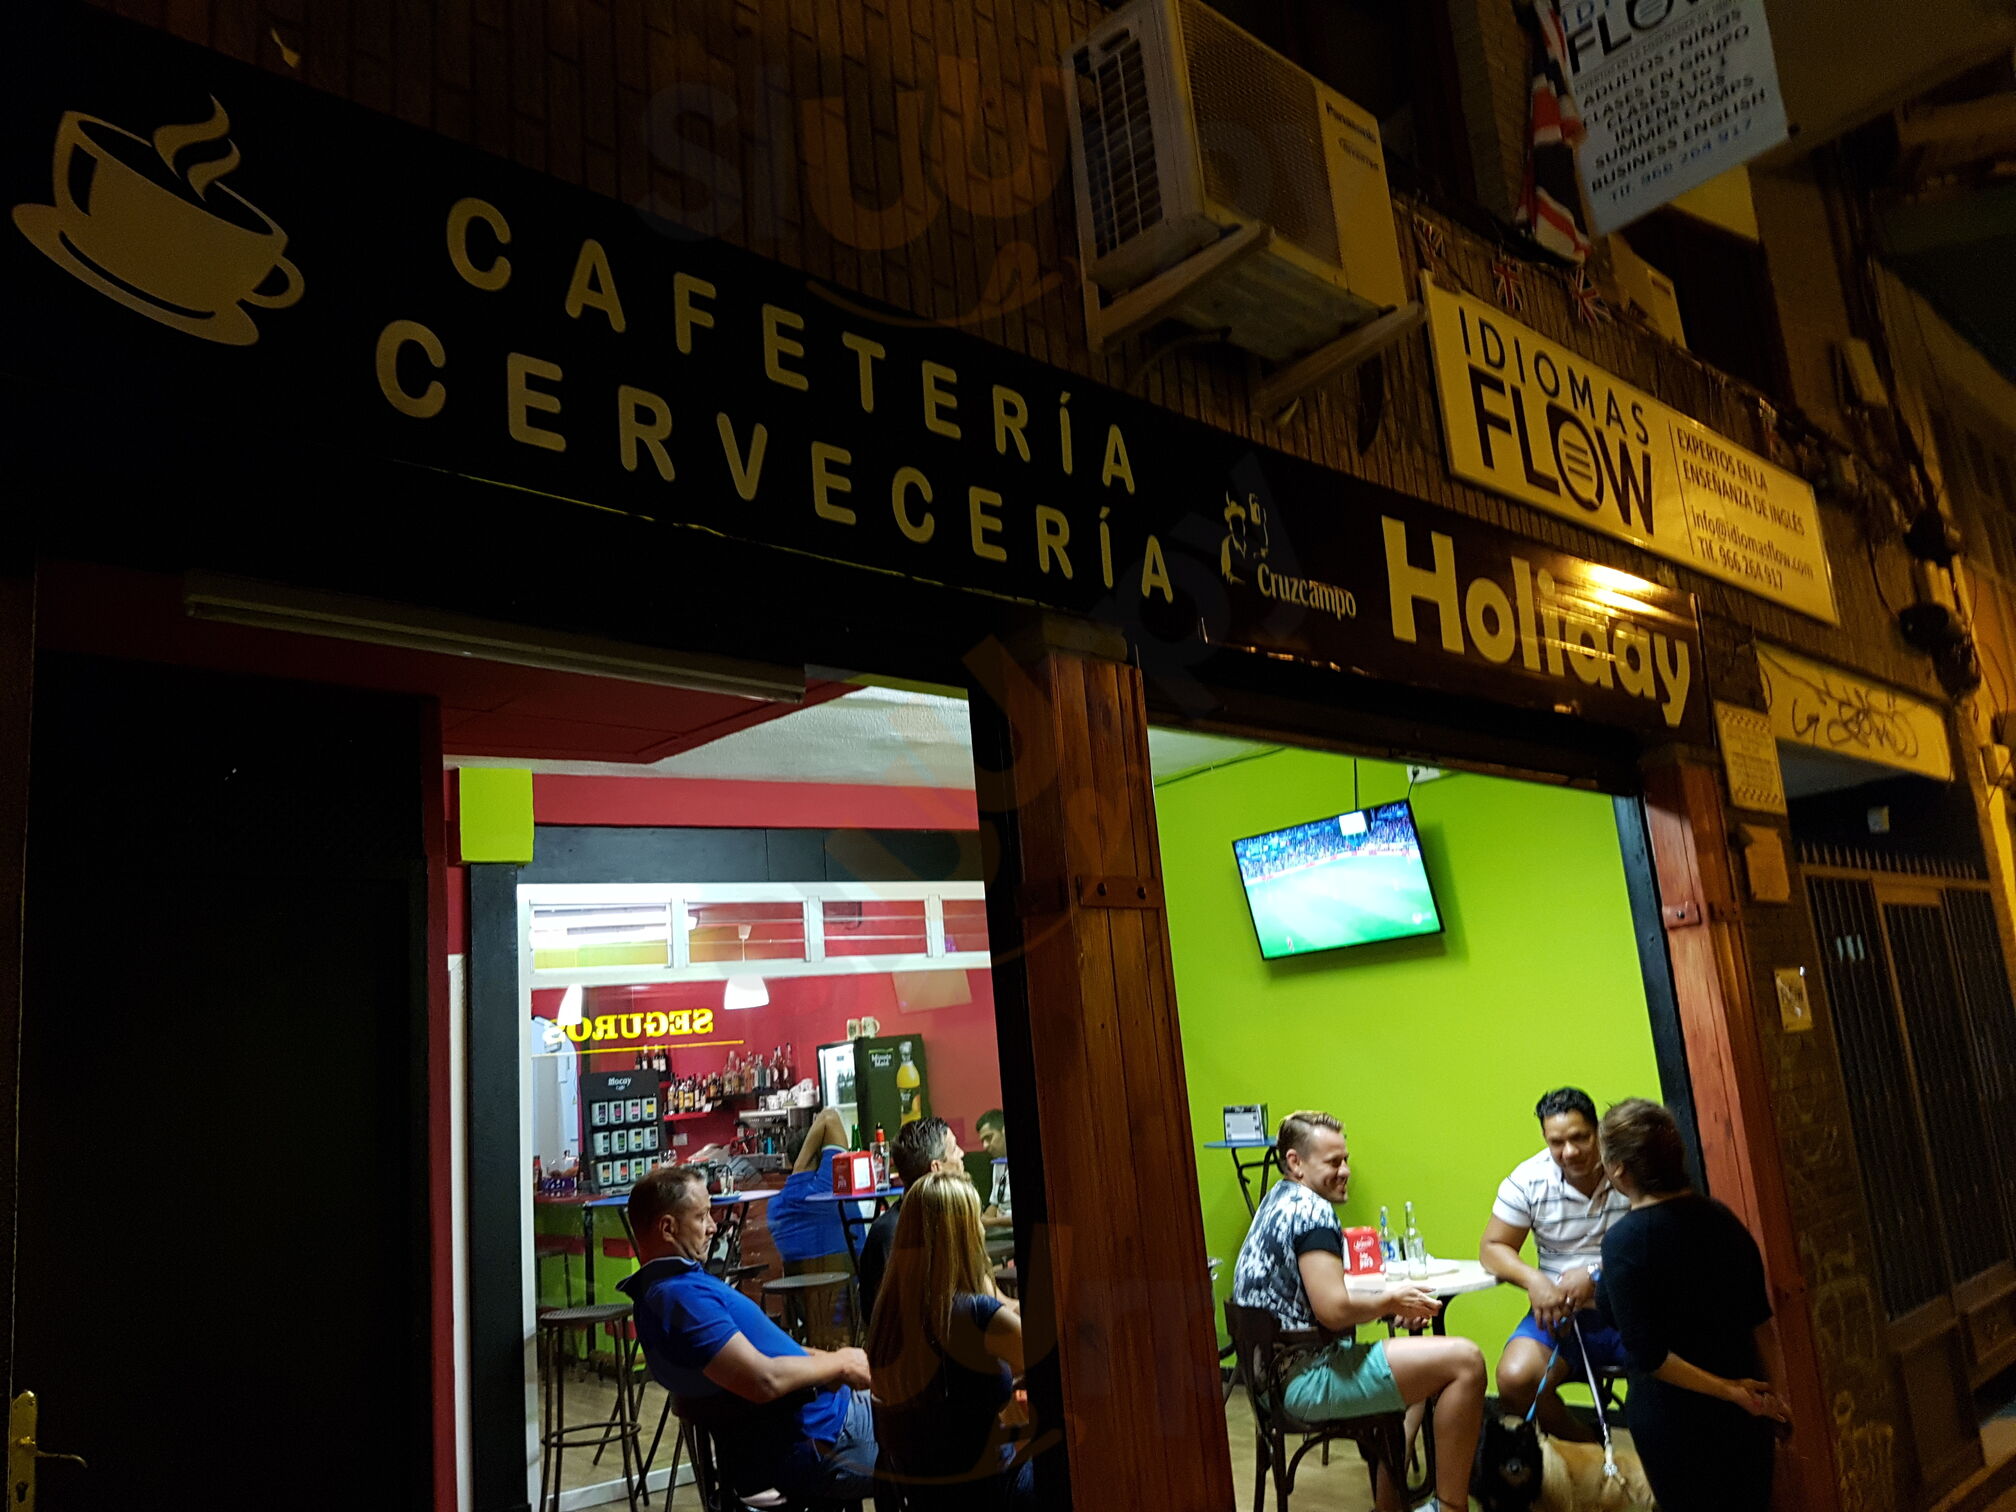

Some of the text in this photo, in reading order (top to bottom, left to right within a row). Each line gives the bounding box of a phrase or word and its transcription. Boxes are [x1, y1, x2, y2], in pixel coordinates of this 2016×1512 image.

[1566, 0, 1699, 74] FLO
[1591, 87, 1767, 193] BUSINESS ENGLISH
[1595, 116, 1680, 170] SUMMER
[446, 197, 1137, 496] CAFETERÍA
[1459, 306, 1650, 446] IDIOMAS
[374, 319, 1174, 604] CERVECERÍA
[1467, 363, 1655, 537] FLOW
[1676, 426, 1769, 493] EXPERTOS EN LA
[1682, 459, 1753, 511] ENSEÑANZA
[1753, 495, 1769, 520] DE
[1256, 562, 1358, 622] Cruzcampo
[1719, 545, 1741, 575] 966
[1742, 555, 1764, 582] 264
[1764, 563, 1785, 592] 917
[1381, 514, 1691, 728] Holiday
